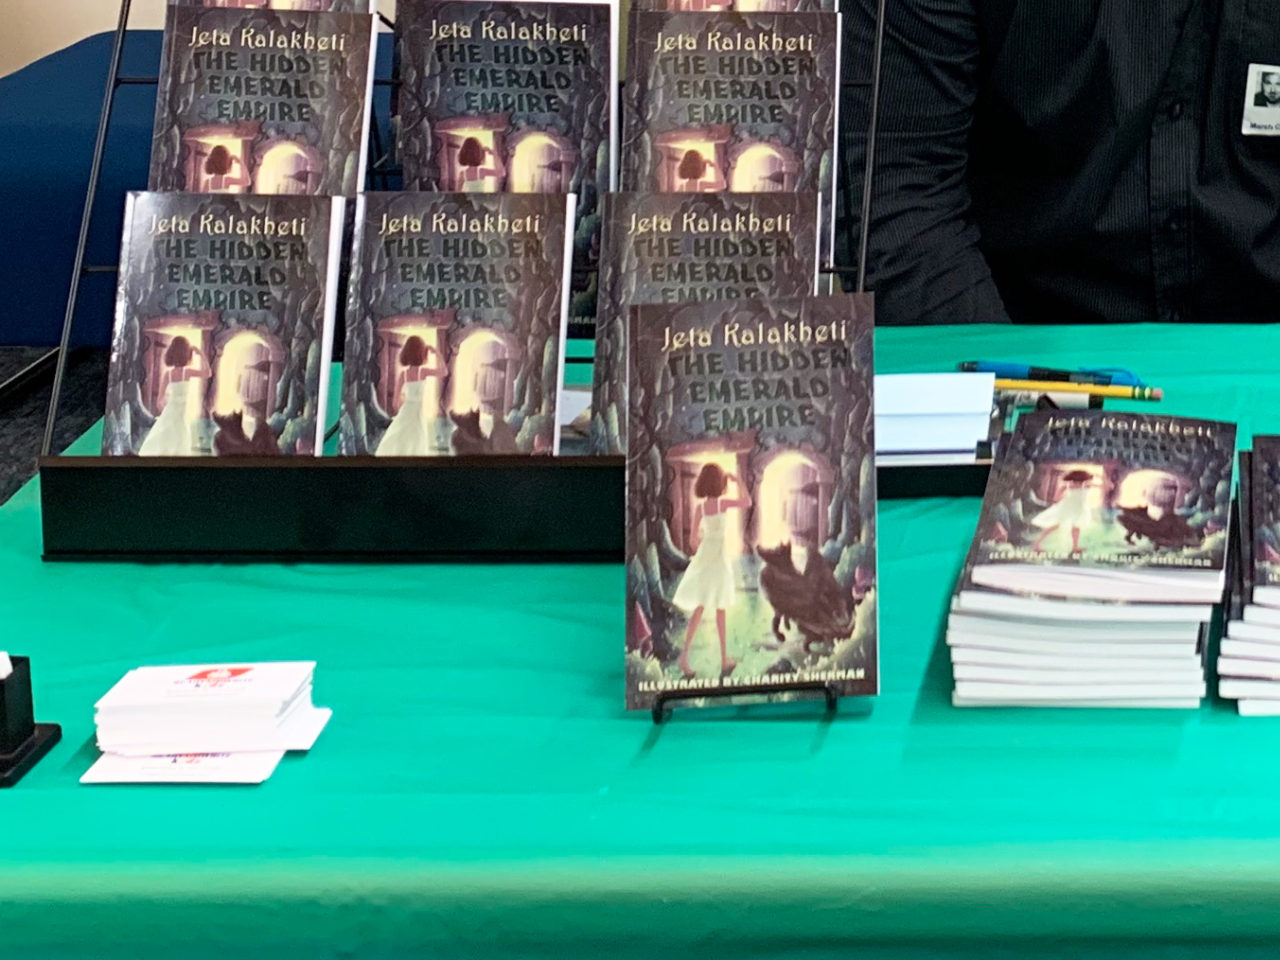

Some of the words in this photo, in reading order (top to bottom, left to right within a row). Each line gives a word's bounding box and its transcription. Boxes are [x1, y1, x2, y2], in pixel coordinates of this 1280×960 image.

[189, 27, 230, 46] Jeta
[241, 28, 345, 51] Kalakheti
[429, 20, 472, 40] Jeta
[482, 21, 586, 42] Kalakheti
[654, 32, 697, 53] Jeta
[708, 32, 813, 52] Kalakheti
[193, 52, 238, 70] THE
[250, 53, 346, 75] HIDDEN
[435, 44, 482, 63] THE
[494, 45, 590, 66] HIDDEN
[659, 56, 706, 75] THE
[718, 56, 817, 75] HIDDEN
[208, 75, 325, 98] EMERALD
[453, 68, 571, 89] EMERALD
[677, 80, 796, 100] EMERALD
[216, 100, 310, 121] EMPIRE
[464, 92, 559, 113] EMPIRE
[687, 104, 783, 124] EMPIRE
[149, 215, 189, 235] Jeta
[200, 214, 306, 237] Kalakheti
[379, 214, 421, 235] Jeta
[432, 213, 540, 234] Kalakheti
[628, 213, 672, 235] Jeta
[683, 213, 792, 233] Kalakheti
[209, 240, 308, 261] HIDDEN
[384, 239, 430, 258] THE
[442, 240, 543, 258] HIDDEN
[633, 238, 681, 258] THE
[694, 239, 793, 258] HIDDEN
[168, 264, 286, 285] EMERALD
[400, 263, 521, 283] EMERALD
[651, 263, 773, 284] EMERALD
[177, 289, 272, 310] EMPIRE
[410, 288, 508, 309] EMPIRE
[661, 327, 712, 352] Jeta
[724, 320, 847, 348] Kalakheti
[667, 353, 724, 376] THE
[738, 348, 849, 373] HIDDEN
[689, 378, 829, 404] EMERALD
[702, 404, 817, 432] EMPIRE
[638, 678, 720, 692] ILLUSTRATED
[723, 677, 739, 686] BY
[743, 672, 800, 686] CHARITY
[803, 669, 865, 681] SHERMAN
